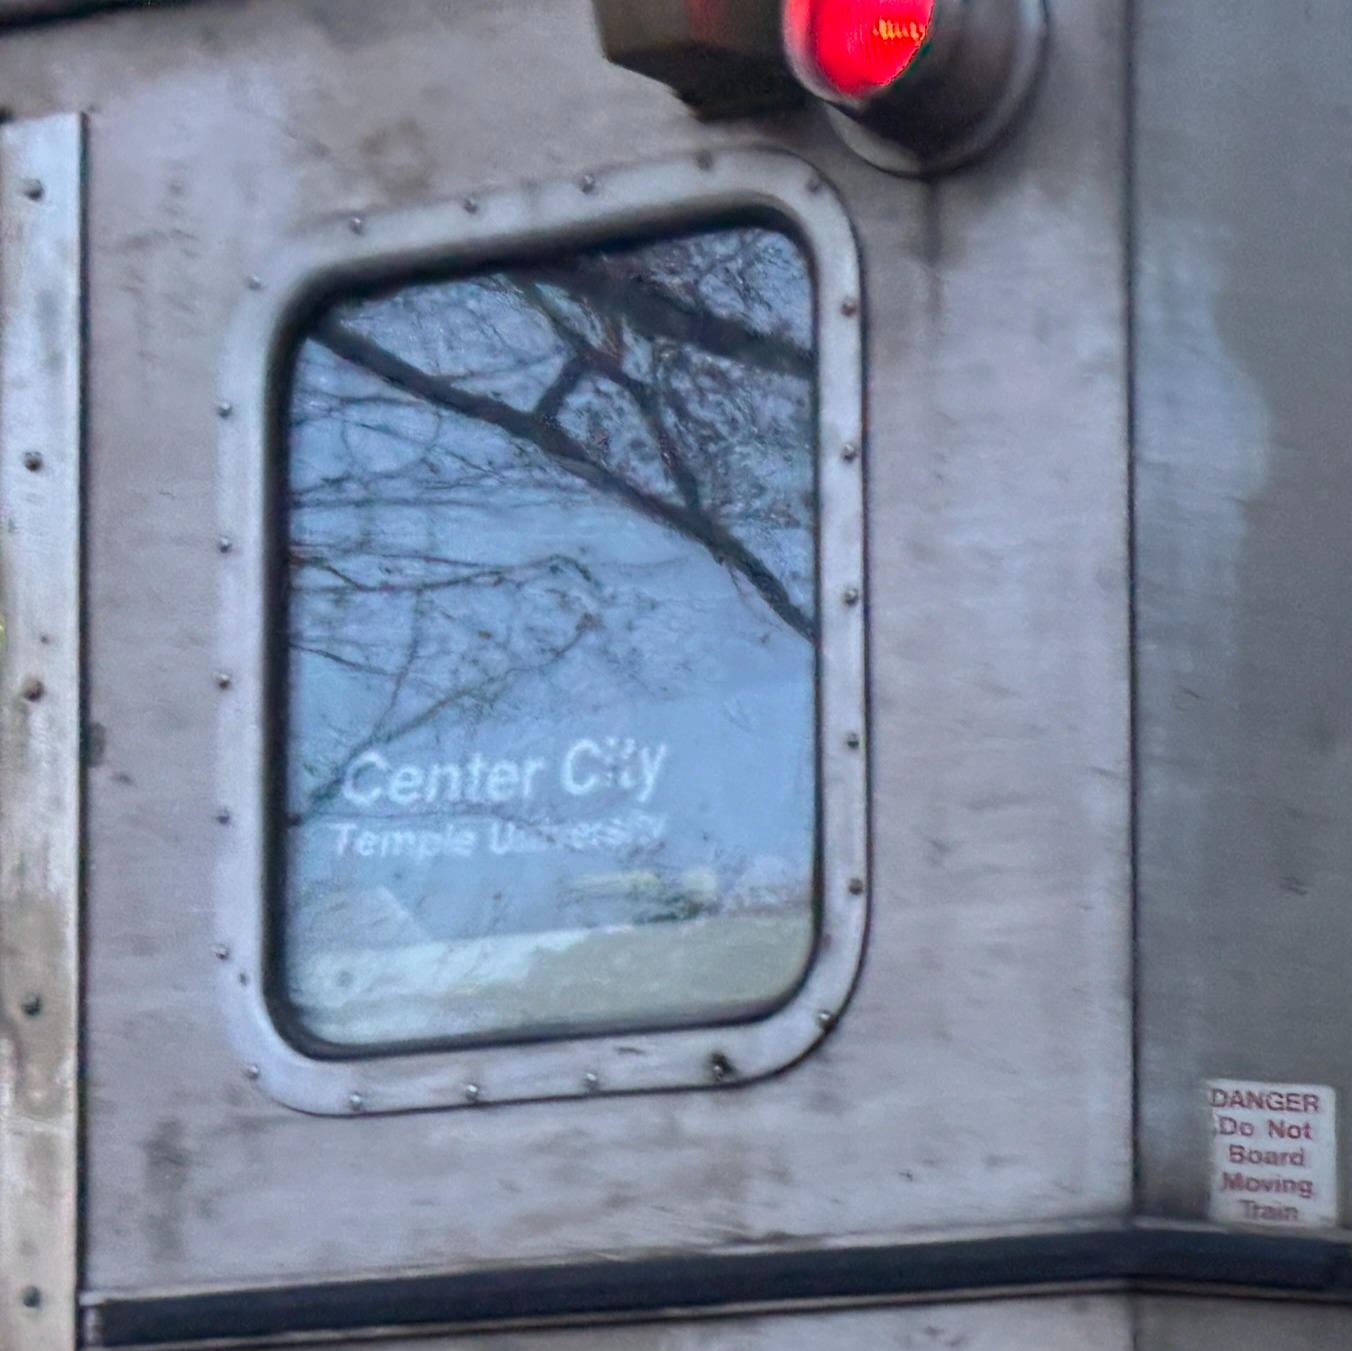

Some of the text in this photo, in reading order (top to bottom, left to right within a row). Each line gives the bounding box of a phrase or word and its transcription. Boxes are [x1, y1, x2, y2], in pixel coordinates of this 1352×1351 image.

[340, 737, 668, 806] Center City
[489, 811, 668, 854] Uersiy
[1209, 1088, 1320, 1113] DANGER
[1218, 1116, 1313, 1141] Do Not
[1228, 1144, 1306, 1167] Board
[1221, 1171, 1314, 1199] Moving
[1239, 1199, 1299, 1221] Train
